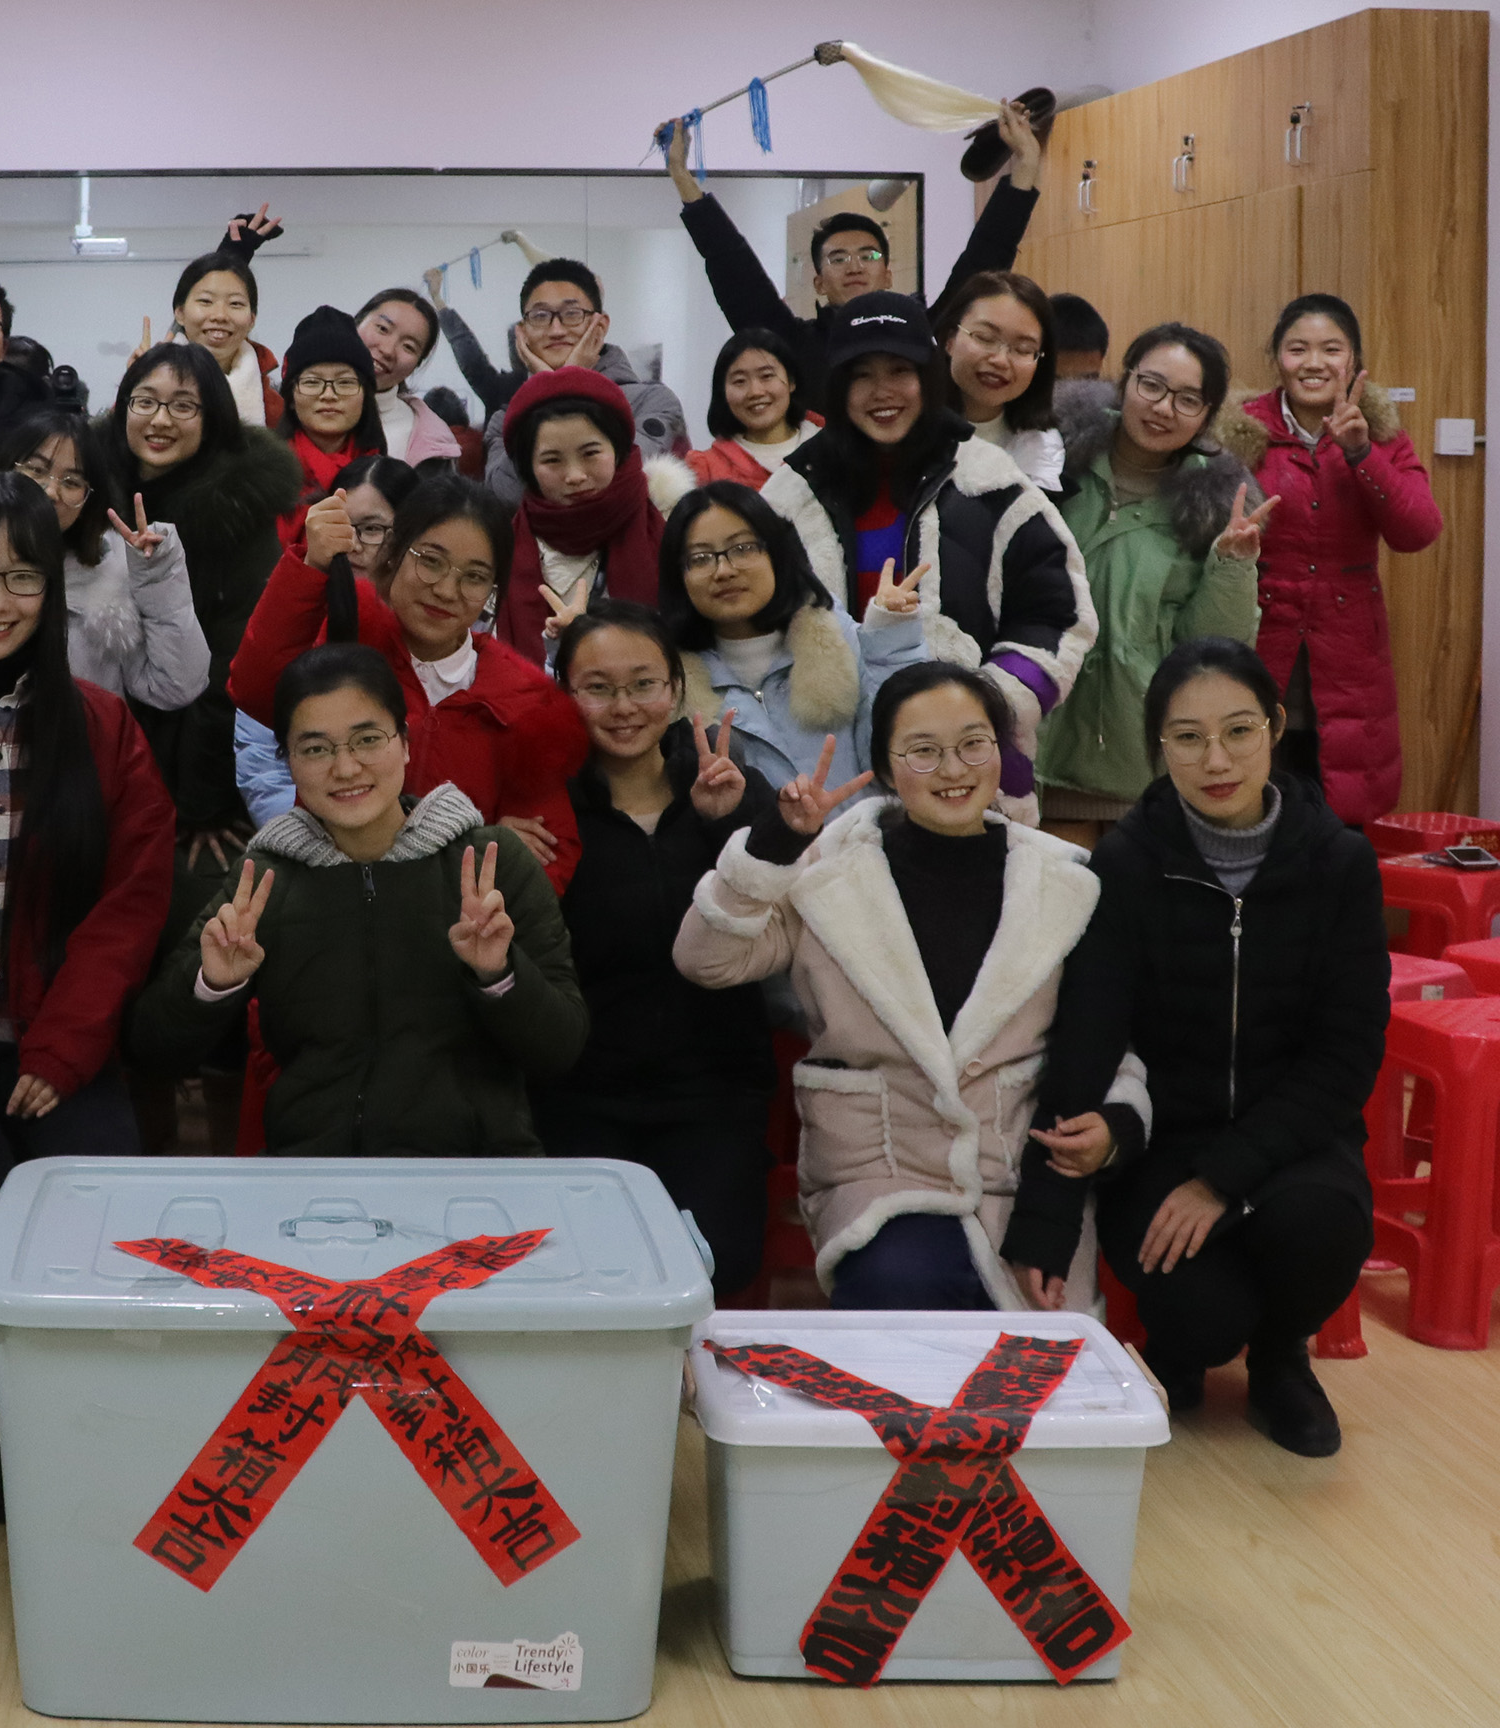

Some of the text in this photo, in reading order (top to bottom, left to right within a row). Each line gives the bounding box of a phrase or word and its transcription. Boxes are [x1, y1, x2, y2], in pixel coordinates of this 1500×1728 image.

[851, 315, 907, 326] Champion
[457, 1645, 489, 1658] color
[516, 1645, 565, 1660] Trendy
[454, 1663, 490, 1674] 小国乐
[514, 1659, 574, 1675] Lifestyle
